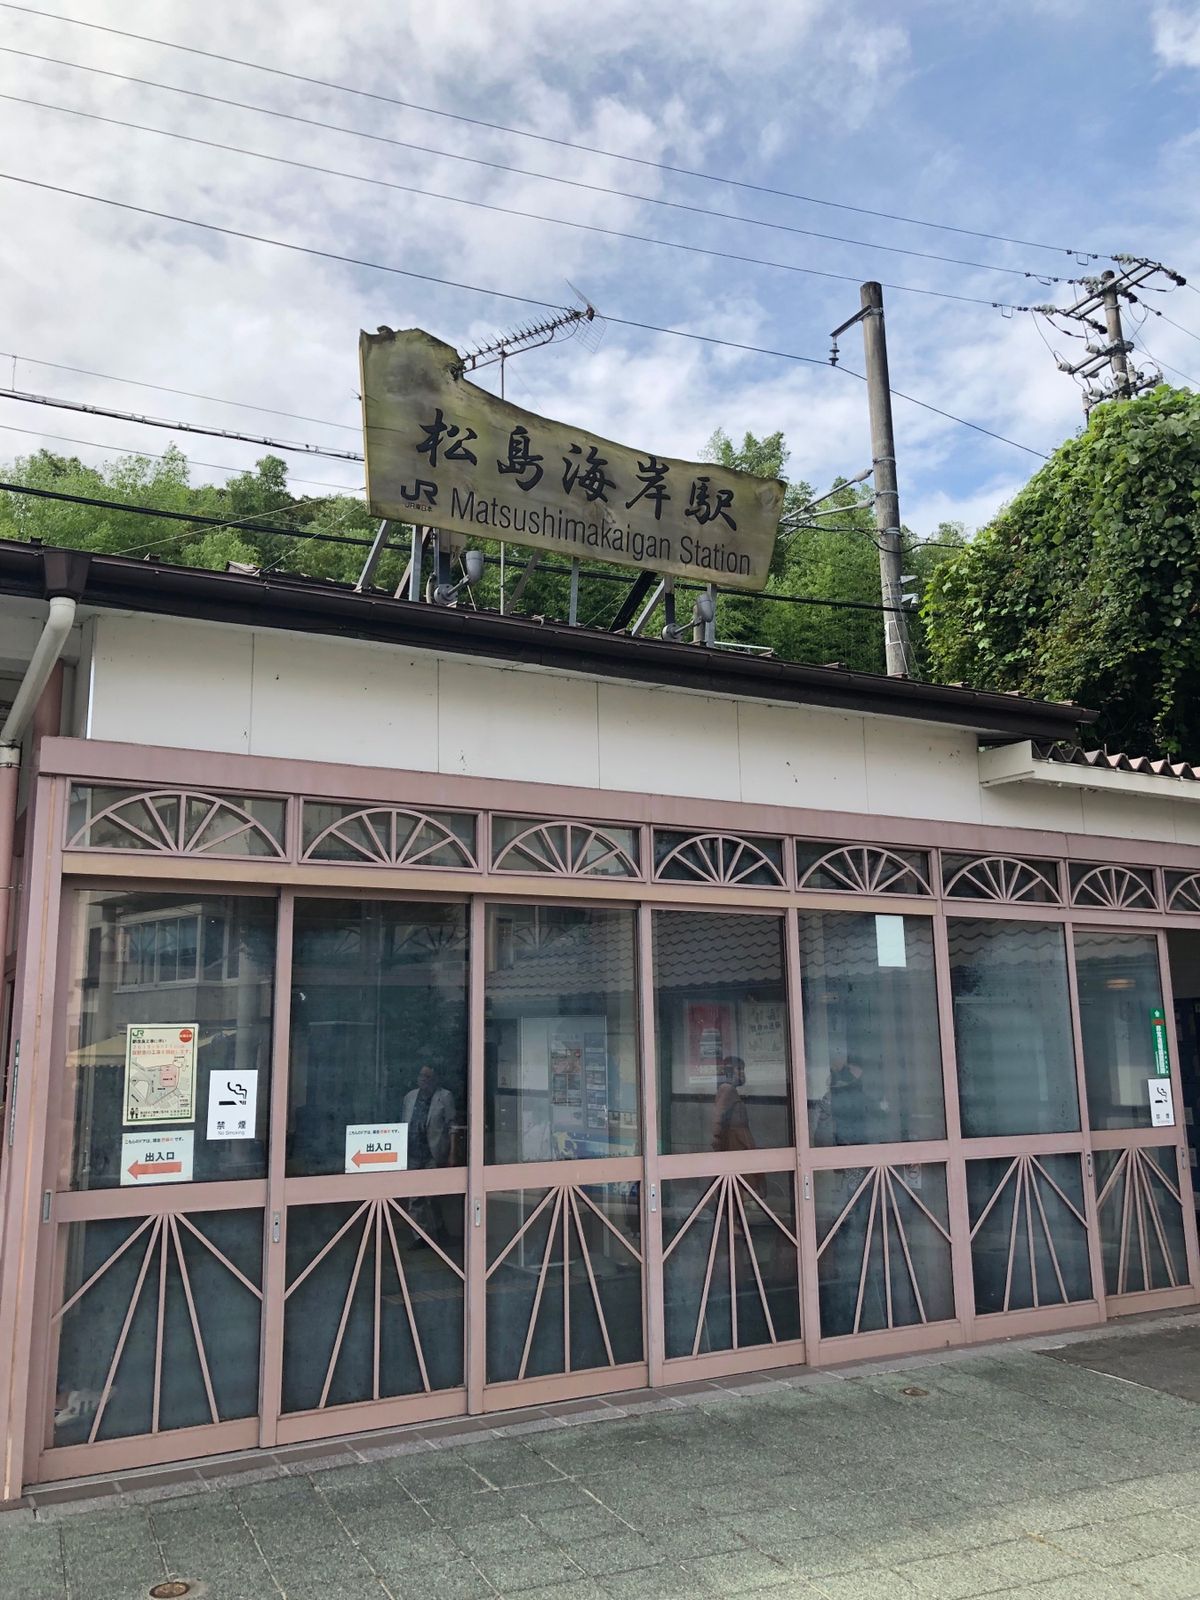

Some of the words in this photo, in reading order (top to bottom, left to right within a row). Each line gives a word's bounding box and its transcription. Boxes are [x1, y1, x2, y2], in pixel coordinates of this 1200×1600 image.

[416, 408, 737, 531] 松島海岸駅
[400, 479, 437, 505] JR
[450, 487, 671, 562] Matsushimakaigan
[679, 535, 751, 577] Station
[132, 1029, 144, 1037] JR
[366, 1142, 392, 1152] 出入口
[145, 1152, 175, 1162] 出入口
